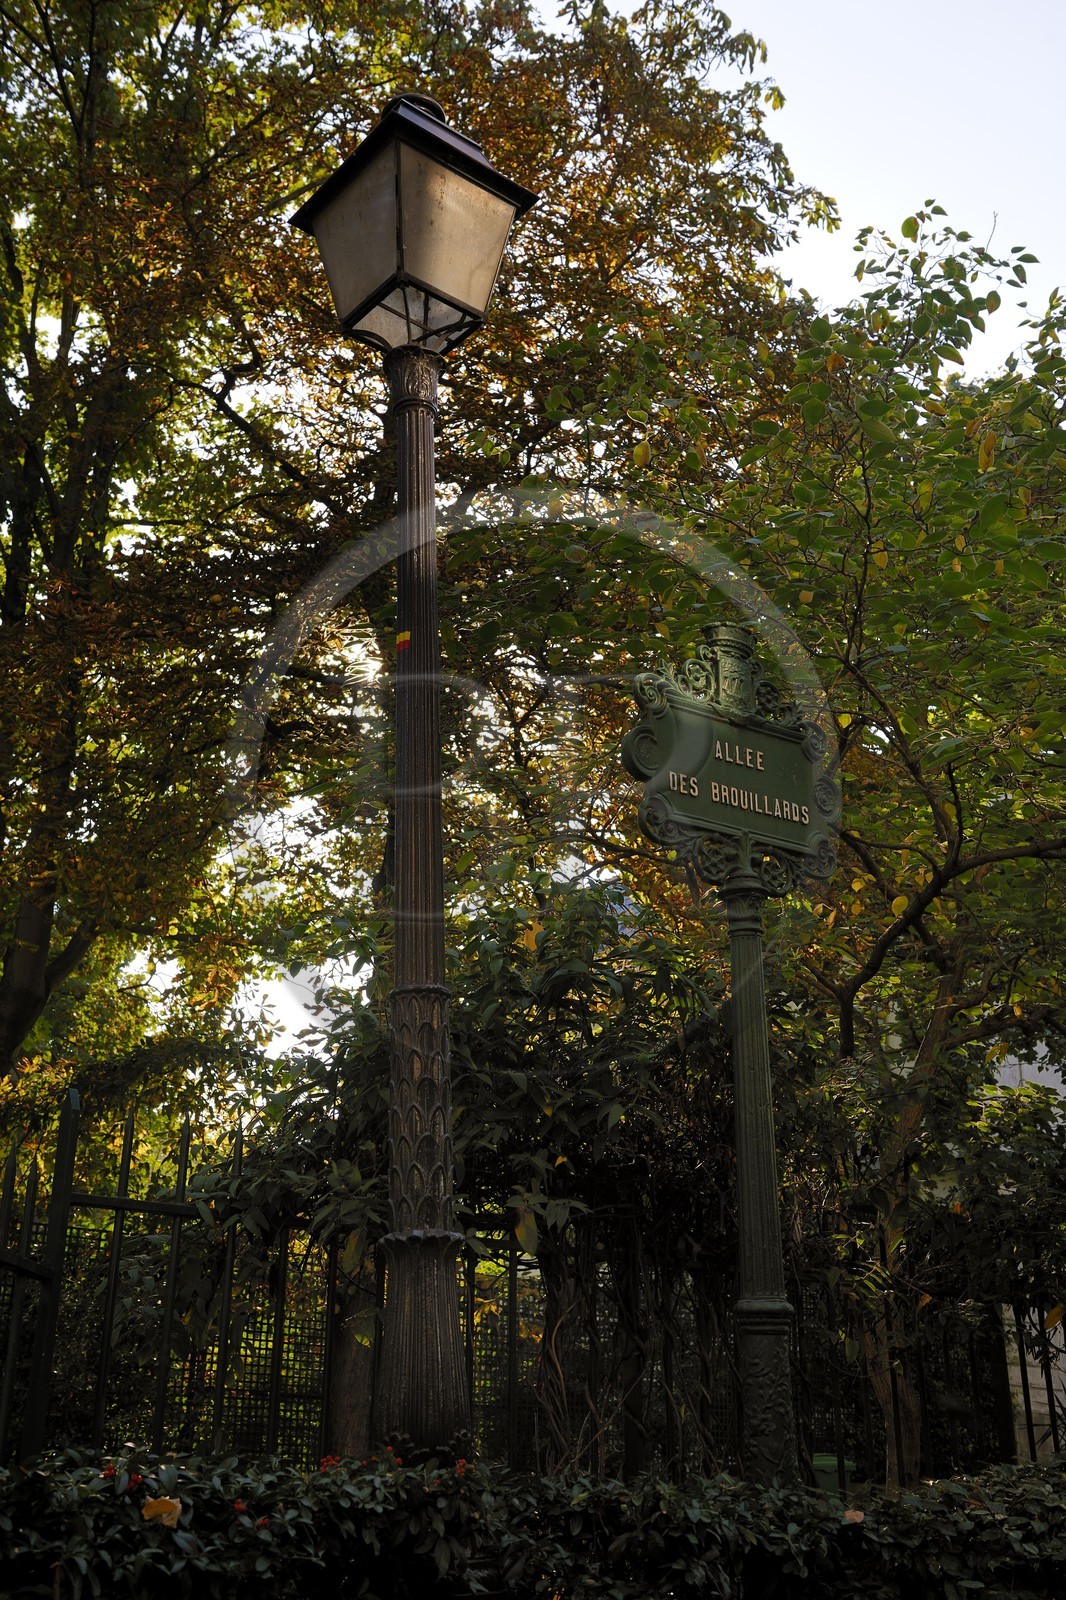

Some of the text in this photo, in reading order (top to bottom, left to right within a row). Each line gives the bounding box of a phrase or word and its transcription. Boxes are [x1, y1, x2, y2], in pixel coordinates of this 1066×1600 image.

[714, 740, 765, 772] ALLEE
[668, 770, 810, 825] DES BROUILLARDS
